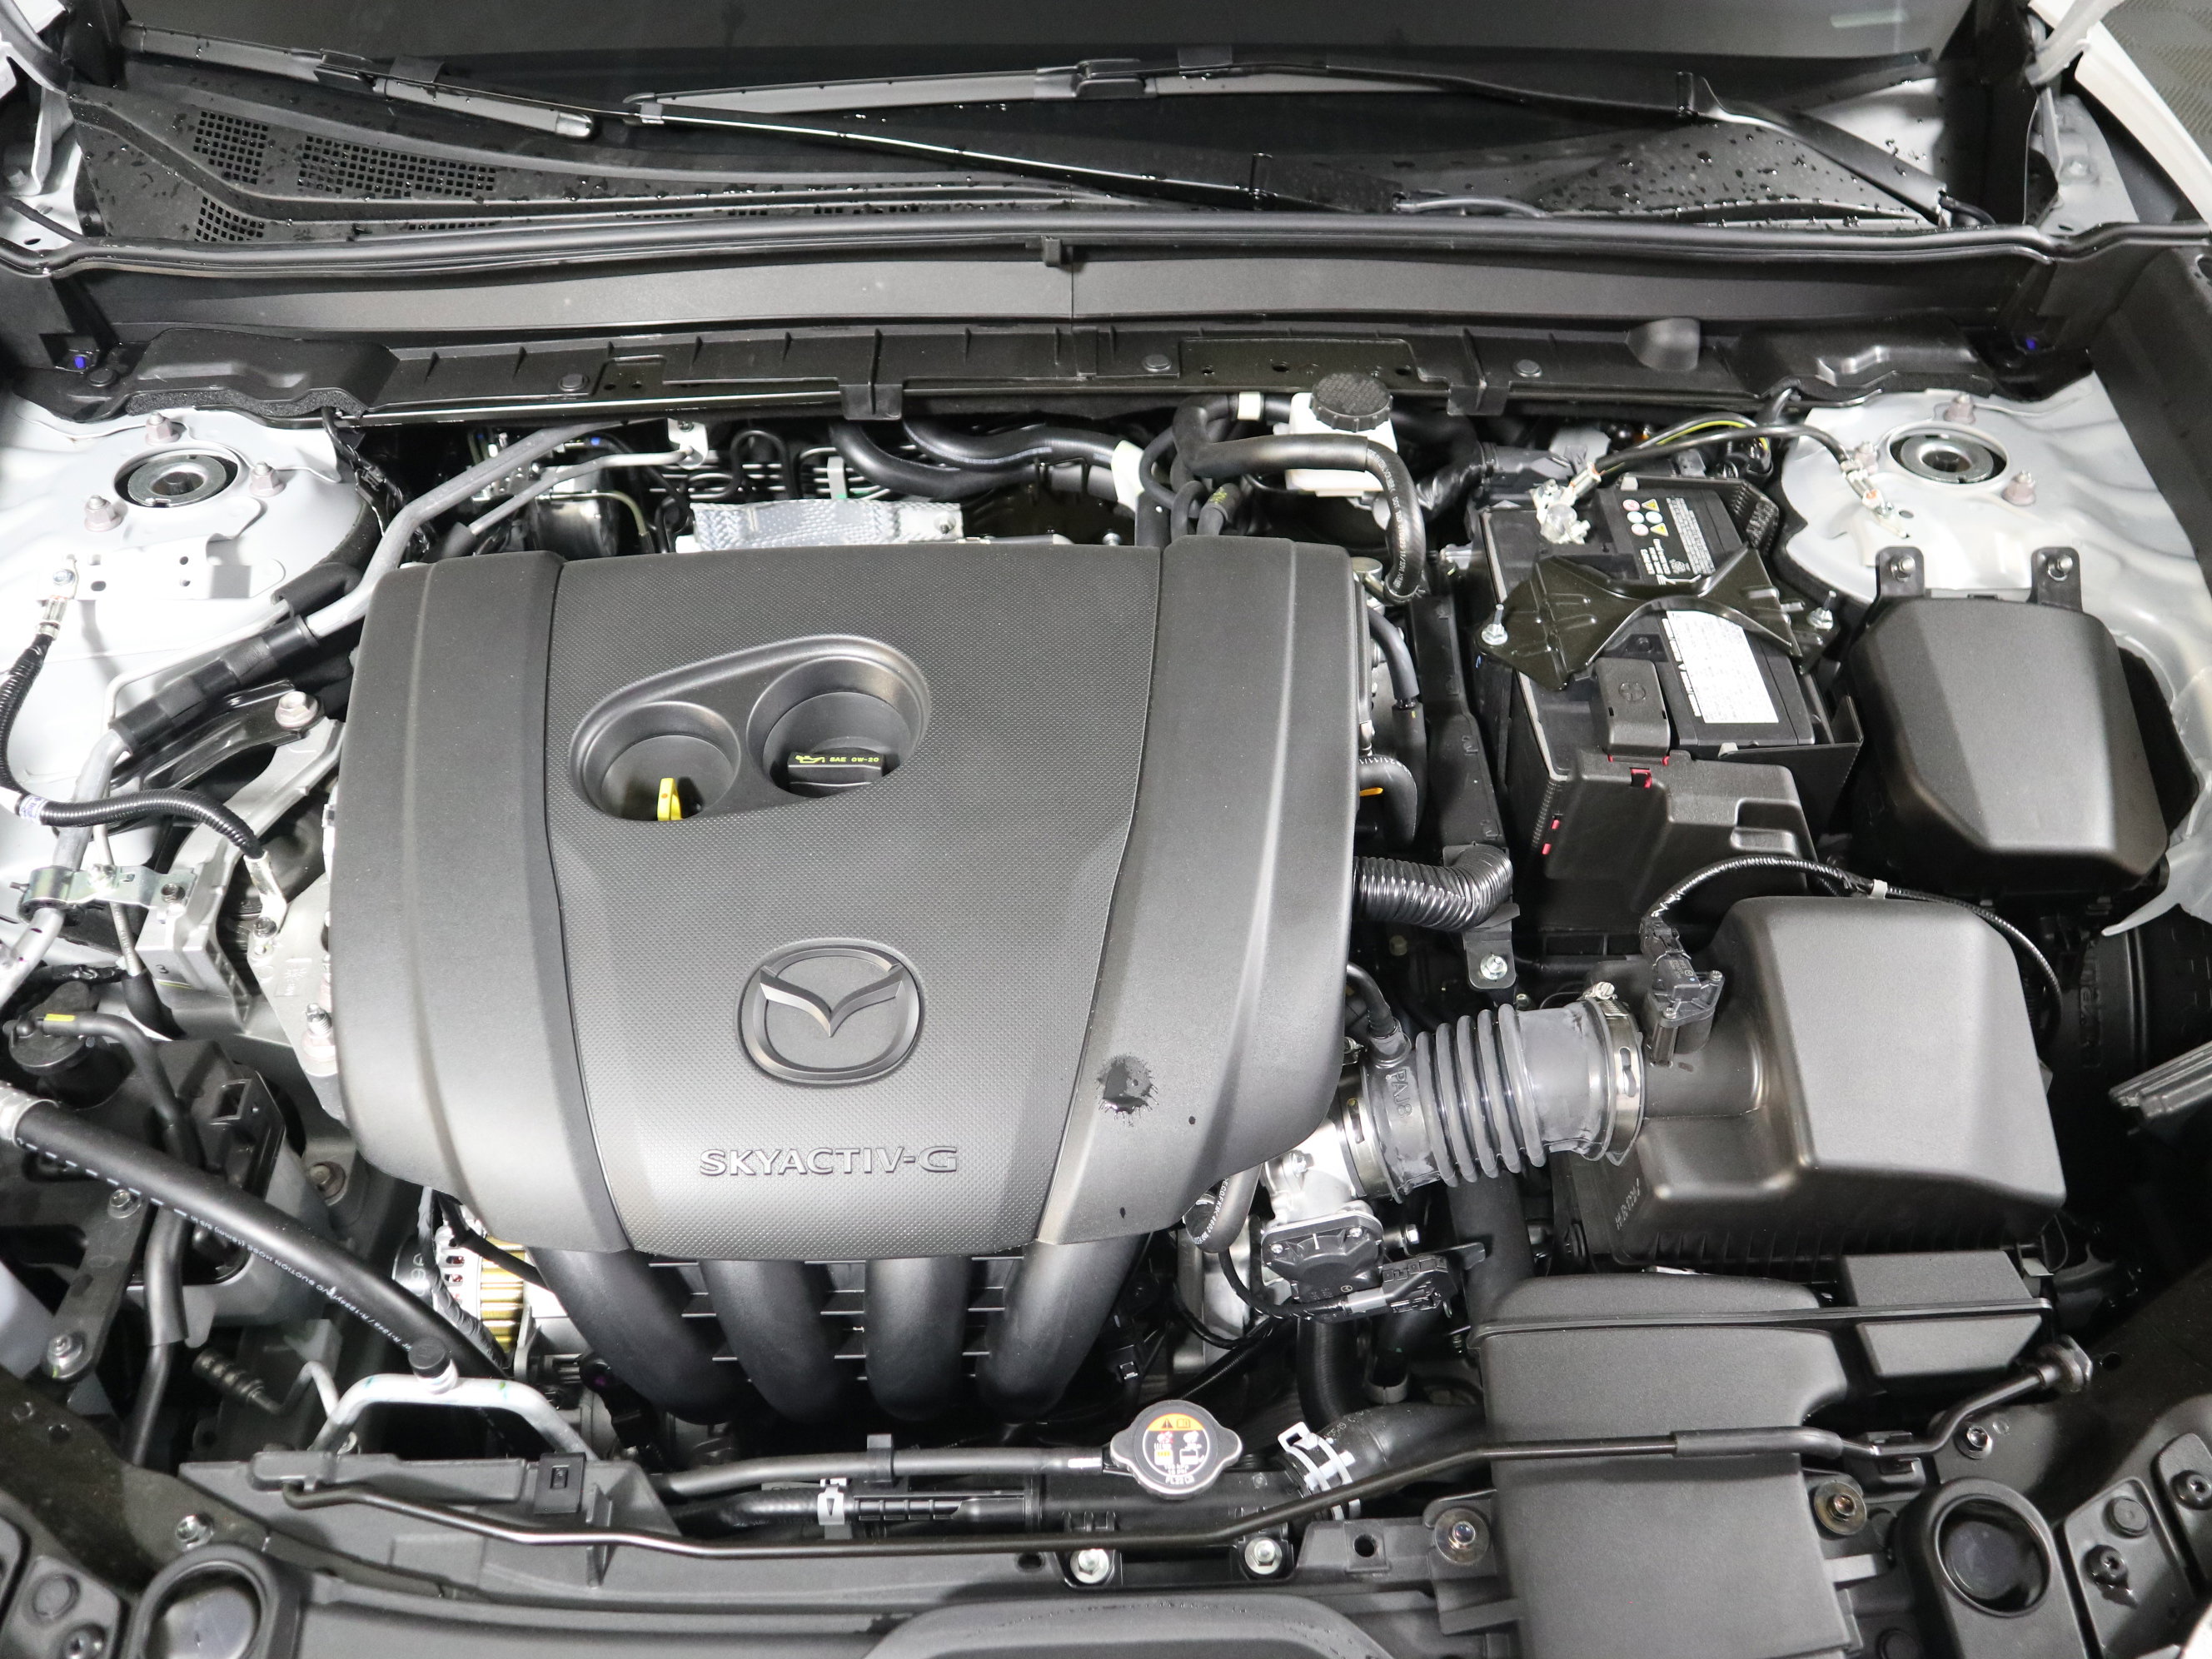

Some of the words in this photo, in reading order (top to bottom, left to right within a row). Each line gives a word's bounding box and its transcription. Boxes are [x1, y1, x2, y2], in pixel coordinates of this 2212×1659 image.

[1390, 1069, 1412, 1117] PAJ8
[700, 1146, 957, 1176] SKYACTIV-G
[247, 1243, 273, 1262] HOSE
[274, 1259, 316, 1286] SUCTION
